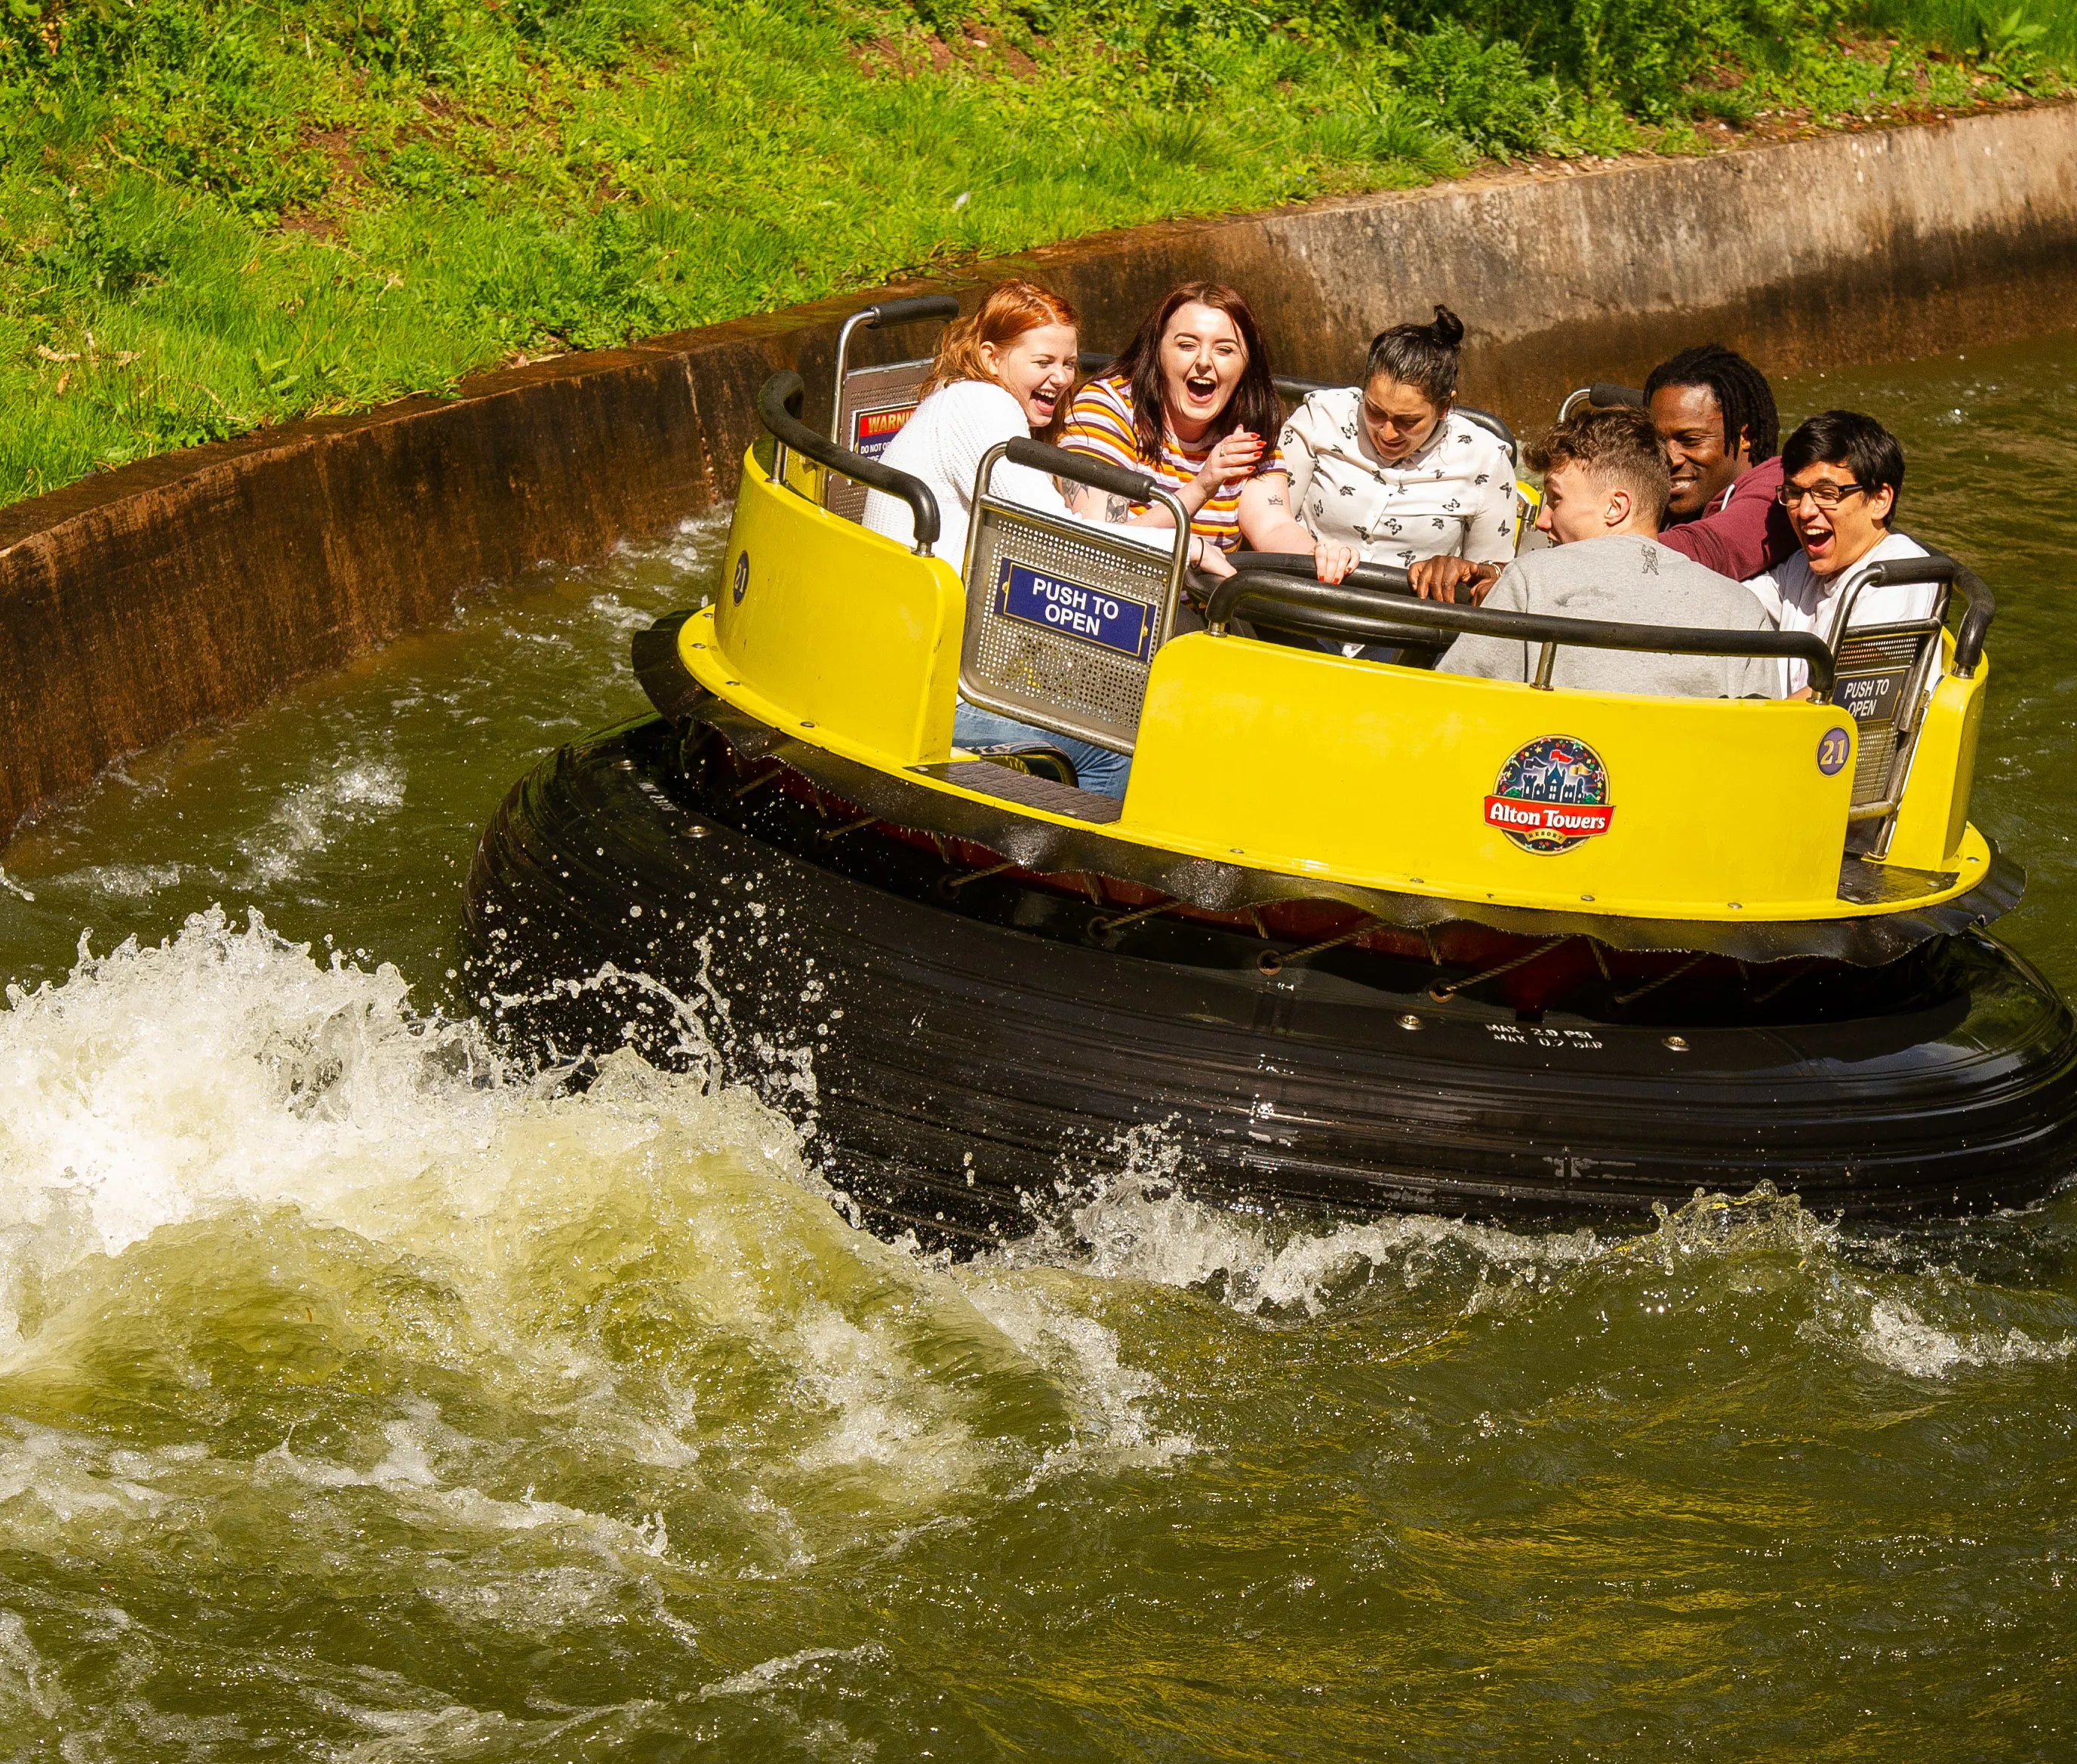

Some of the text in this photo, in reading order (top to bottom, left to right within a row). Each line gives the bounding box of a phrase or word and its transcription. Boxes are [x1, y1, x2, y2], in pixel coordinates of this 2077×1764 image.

[860, 445, 869, 454] DO
[870, 443, 882, 453] NOT
[734, 562, 747, 593] 21
[1032, 577, 1119, 620] PUSH TO
[1045, 604, 1100, 636] OPEN
[1844, 679, 1890, 700] PUSH TO
[1848, 699, 1877, 718] OPEN
[1820, 739, 1845, 765] 21
[1490, 802, 1606, 830] Alton Towers
[1528, 831, 1563, 841] RESORT
[1564, 1030, 1593, 1039] PSI
